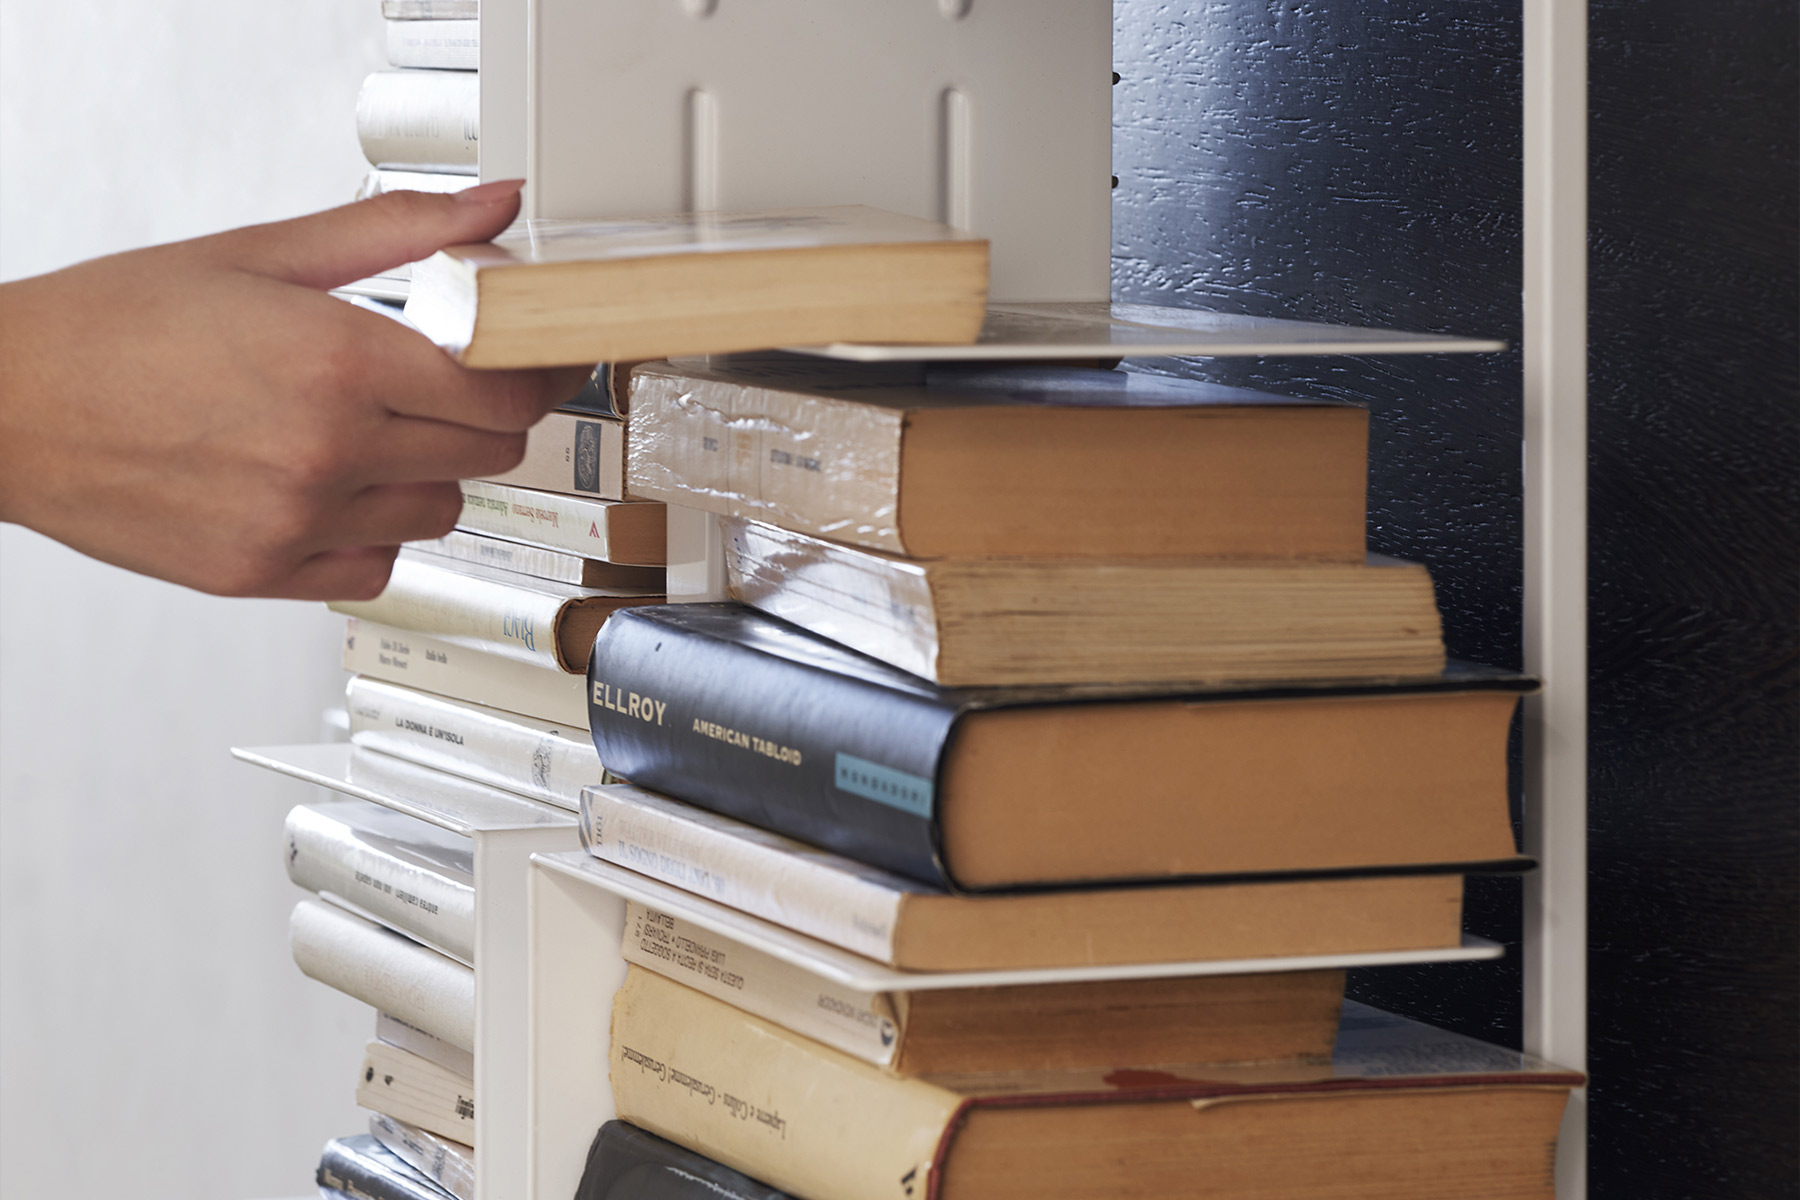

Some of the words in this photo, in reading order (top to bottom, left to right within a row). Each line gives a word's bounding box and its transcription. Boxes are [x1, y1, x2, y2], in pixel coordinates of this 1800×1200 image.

[395, 717, 404, 728] LA
[405, 719, 428, 735] DONNA
[593, 680, 667, 726] ELLROY
[692, 718, 750, 750] AMERICAN
[751, 736, 803, 767] TABLOID
[643, 923, 670, 945] TROVARSI
[640, 938, 672, 961] SOGGETTO
[676, 936, 710, 960] PIRANDELLO
[710, 948, 726, 966] LUIGI
[677, 954, 697, 972] RECITA
[697, 961, 704, 974] SI
[704, 964, 720, 981] SERA
[720, 971, 745, 990] QUESTA
